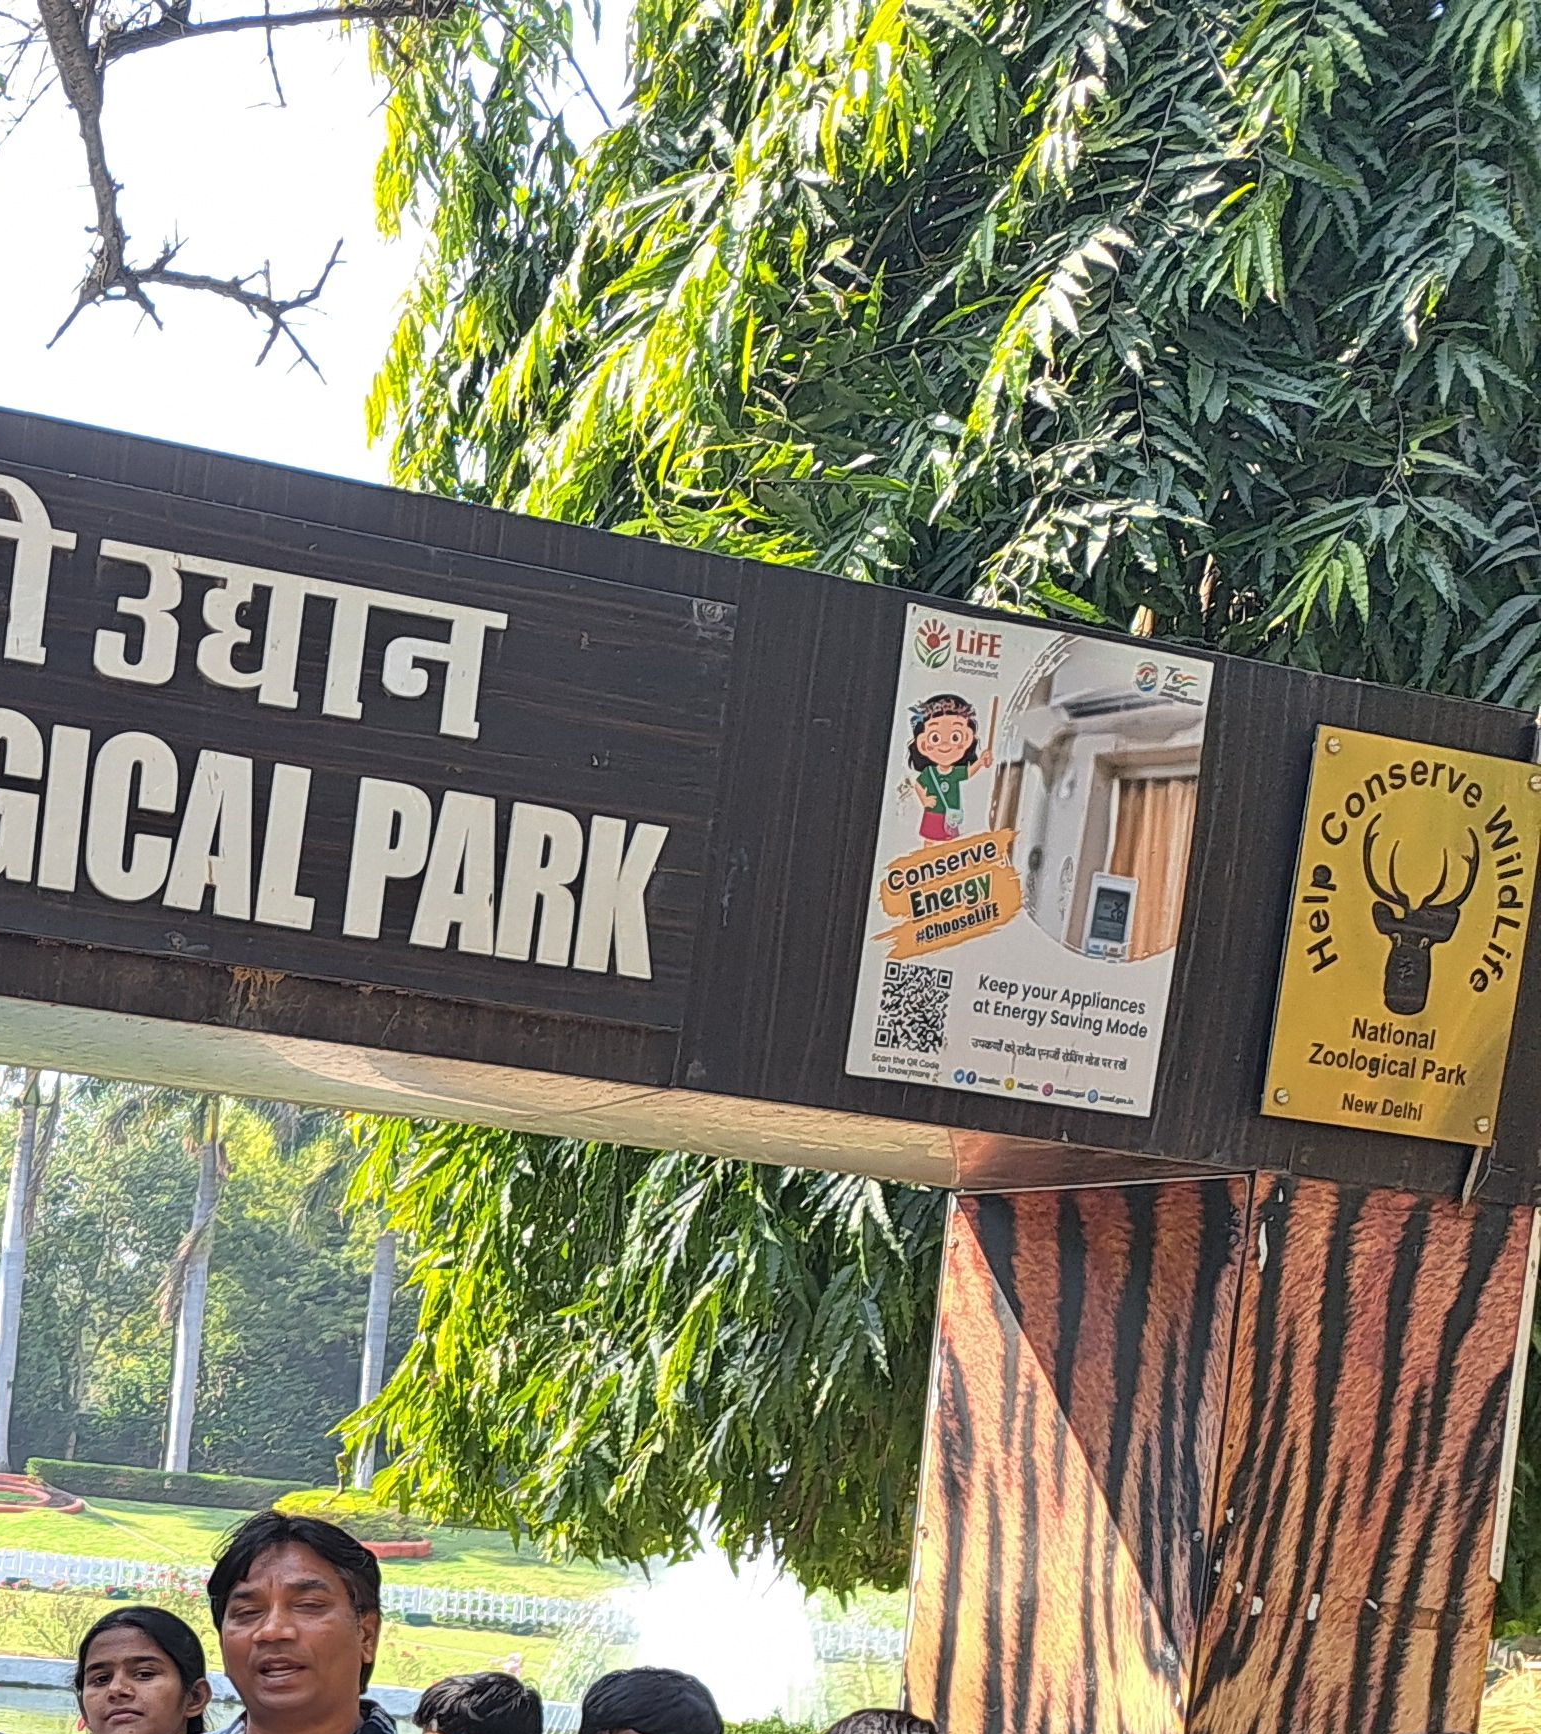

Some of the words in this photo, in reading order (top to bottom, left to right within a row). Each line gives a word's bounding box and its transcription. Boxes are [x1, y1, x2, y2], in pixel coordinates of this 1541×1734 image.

[93, 538, 508, 740] उद्यान
[956, 629, 1001, 658] LiFE
[1322, 760, 1483, 846] Conserve
[343, 777, 669, 980] PARK
[888, 842, 997, 891] Conserve
[910, 873, 992, 918] Energy
[1469, 804, 1524, 993] WildLife
[916, 903, 1000, 944] #ChooseLiFE
[1303, 863, 1338, 974] Help
[978, 974, 1018, 1000] Keep
[1022, 984, 1058, 1001] your
[1060, 989, 1146, 1015] Appliances
[973, 1000, 990, 1014] at
[993, 1001, 1047, 1027] Energy
[1051, 1010, 1103, 1036] Saving
[1106, 1018, 1148, 1038] Mode
[1352, 1017, 1436, 1050] National
[1309, 1043, 1415, 1080] Zoological
[1422, 1059, 1466, 1087] Park
[1342, 1093, 1377, 1117] New
[1381, 1097, 1423, 1121] Delhi
